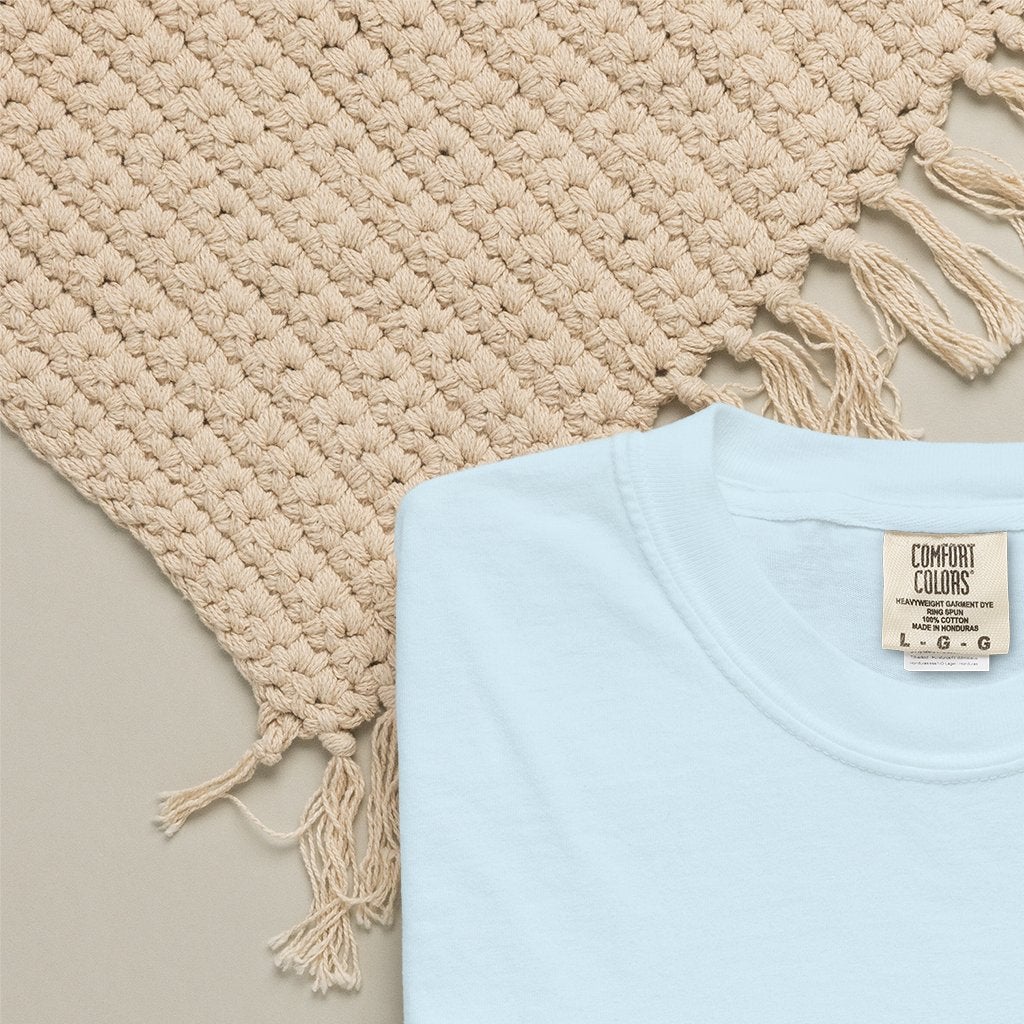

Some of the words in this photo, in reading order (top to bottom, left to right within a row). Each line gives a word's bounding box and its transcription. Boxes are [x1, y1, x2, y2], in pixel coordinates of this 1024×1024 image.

[911, 543, 975, 568] COMFORT
[896, 598, 944, 607] HEAVYWEIGHT
[926, 608, 944, 616] RING
[945, 608, 964, 616] SPUN
[940, 616, 969, 624] COTTON
[912, 623, 932, 631] MADE
[900, 632, 910, 647] L
[936, 635, 950, 650] G
[977, 635, 991, 650] G
